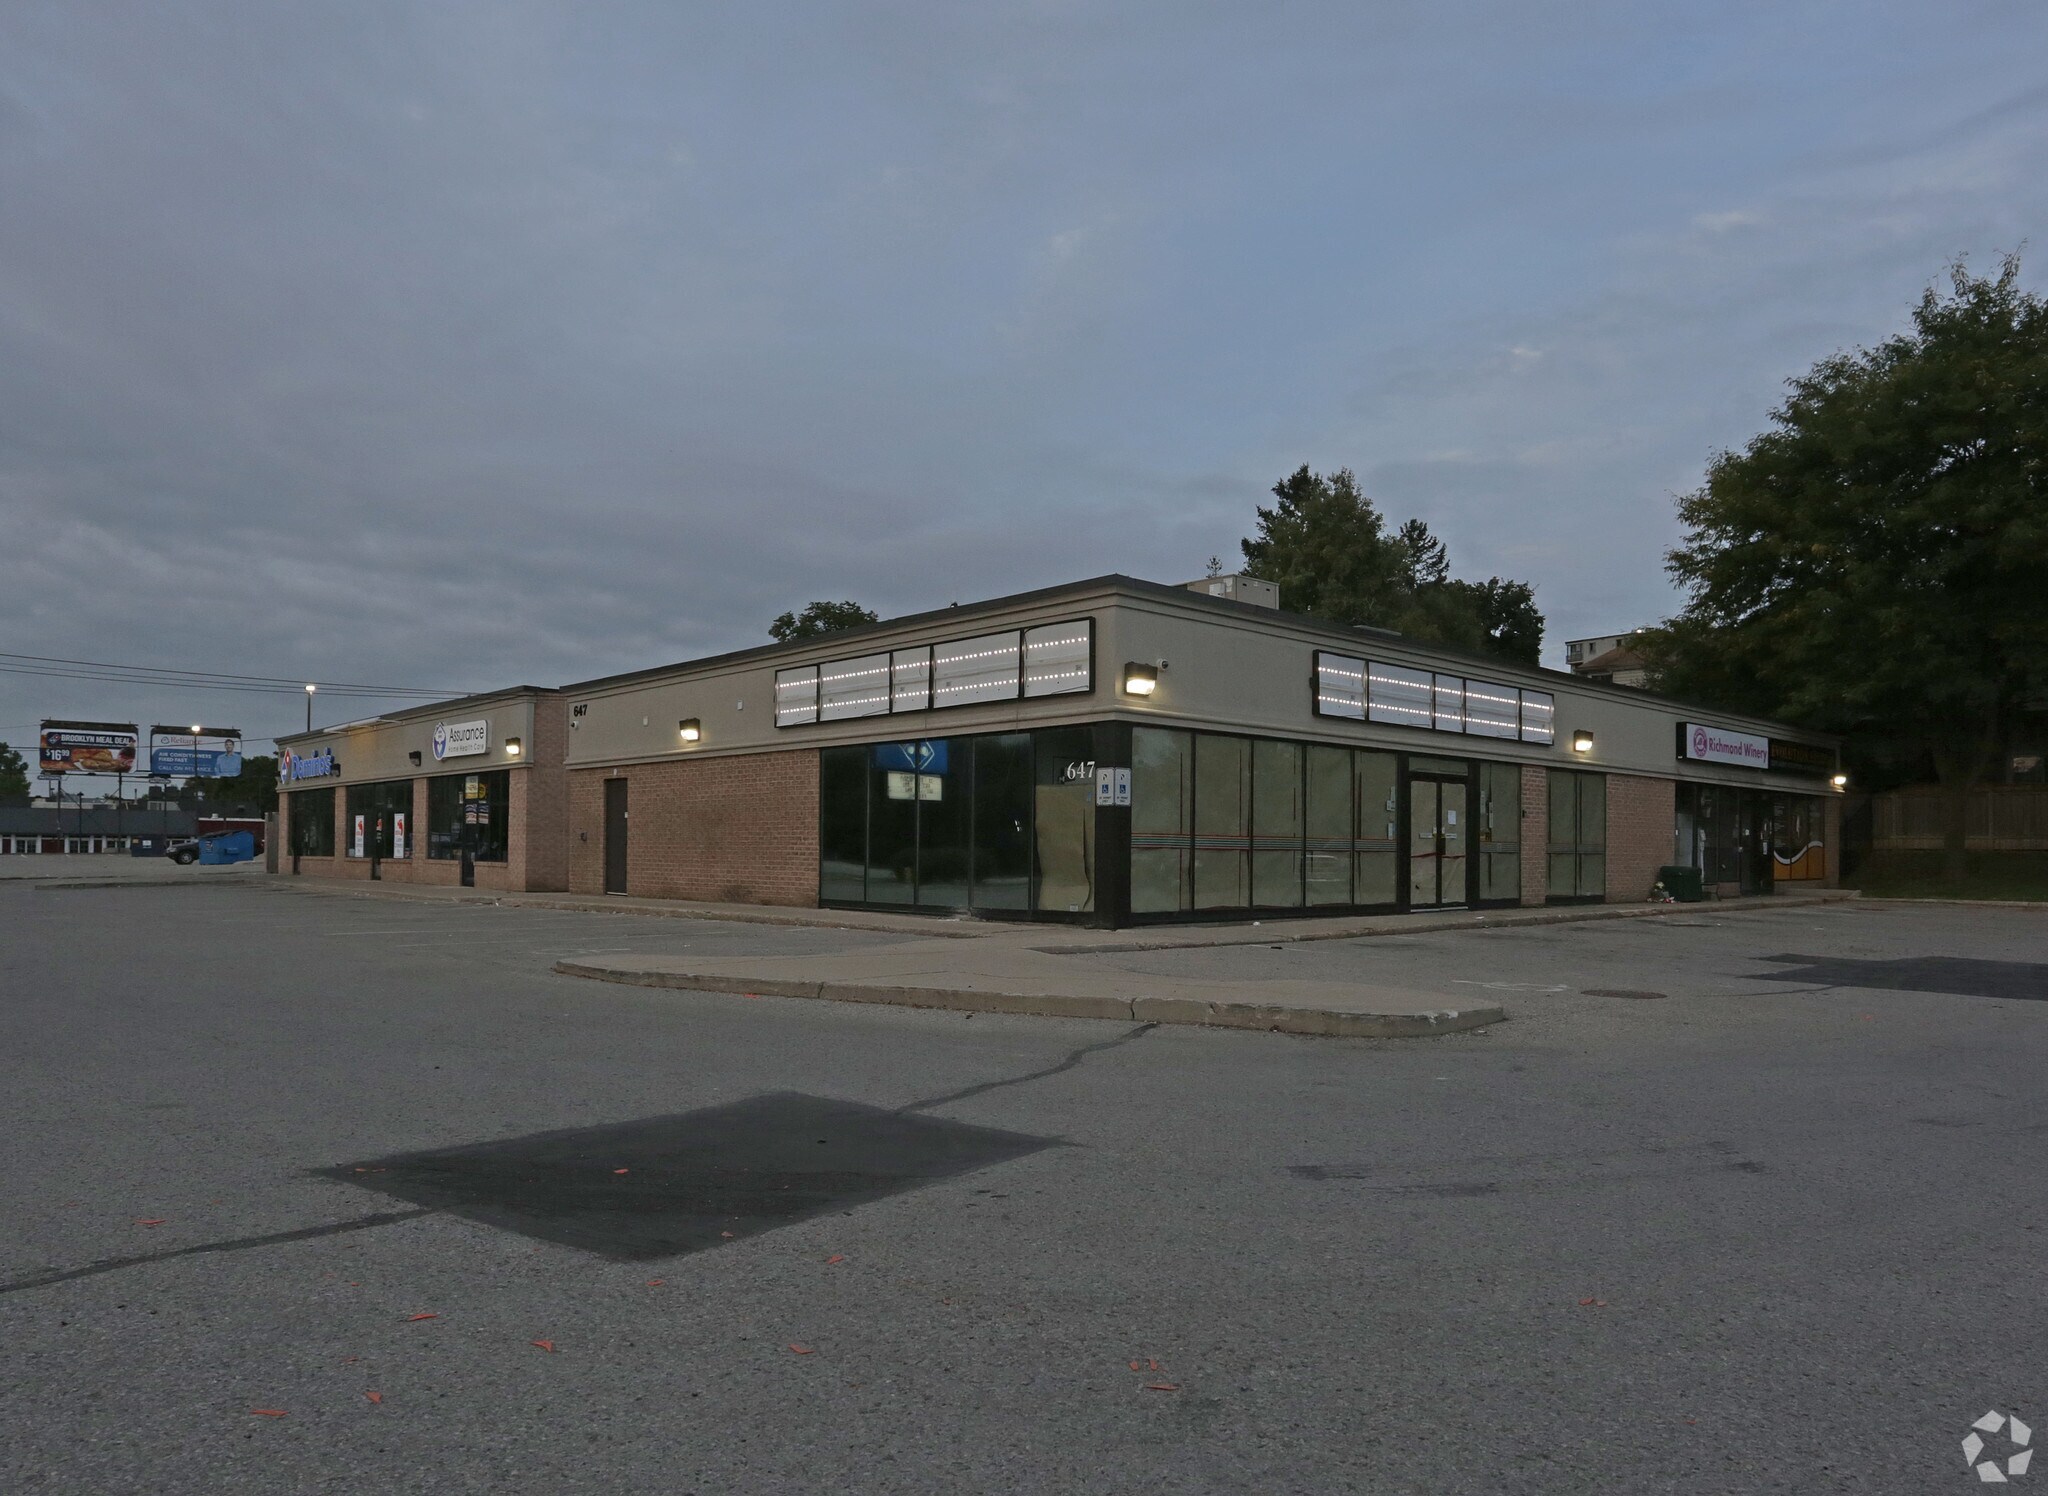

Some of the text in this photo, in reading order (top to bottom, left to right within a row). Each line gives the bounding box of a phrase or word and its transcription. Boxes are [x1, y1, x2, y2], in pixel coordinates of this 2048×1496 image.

[573, 704, 588, 718] 647
[61, 734, 95, 743] BROOKLYN
[95, 735, 113, 744] MEAL
[114, 736, 130, 745] DEAL
[448, 727, 485, 743] Assurance
[1708, 737, 1742, 756] Richmond
[1743, 743, 1767, 763] Winery
[291, 747, 334, 780] Domino's
[1067, 761, 1095, 780] 647
